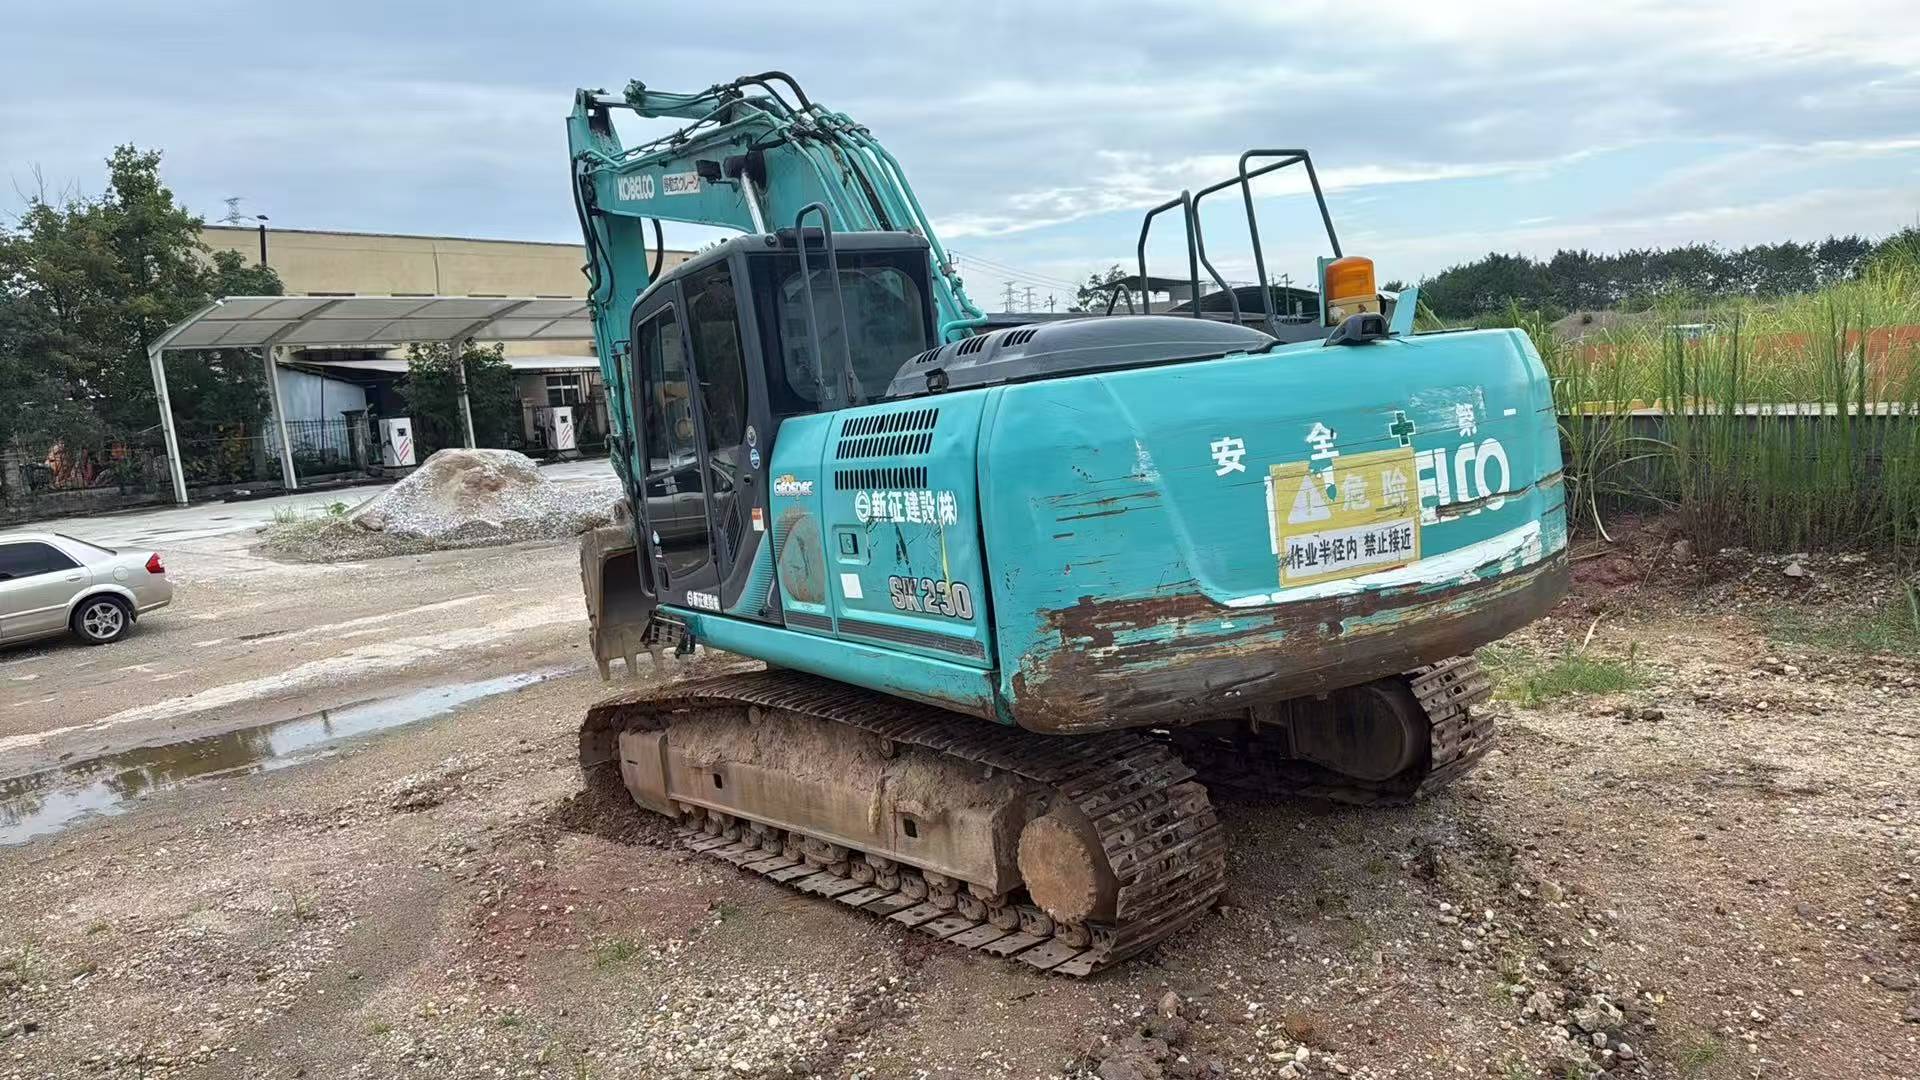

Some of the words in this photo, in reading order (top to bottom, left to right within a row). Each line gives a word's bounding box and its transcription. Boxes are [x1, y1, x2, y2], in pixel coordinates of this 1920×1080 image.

[617, 174, 655, 201] KOBELCO
[1287, 537, 1358, 570] 作业半径内
[1363, 527, 1412, 558] 禁止接近
